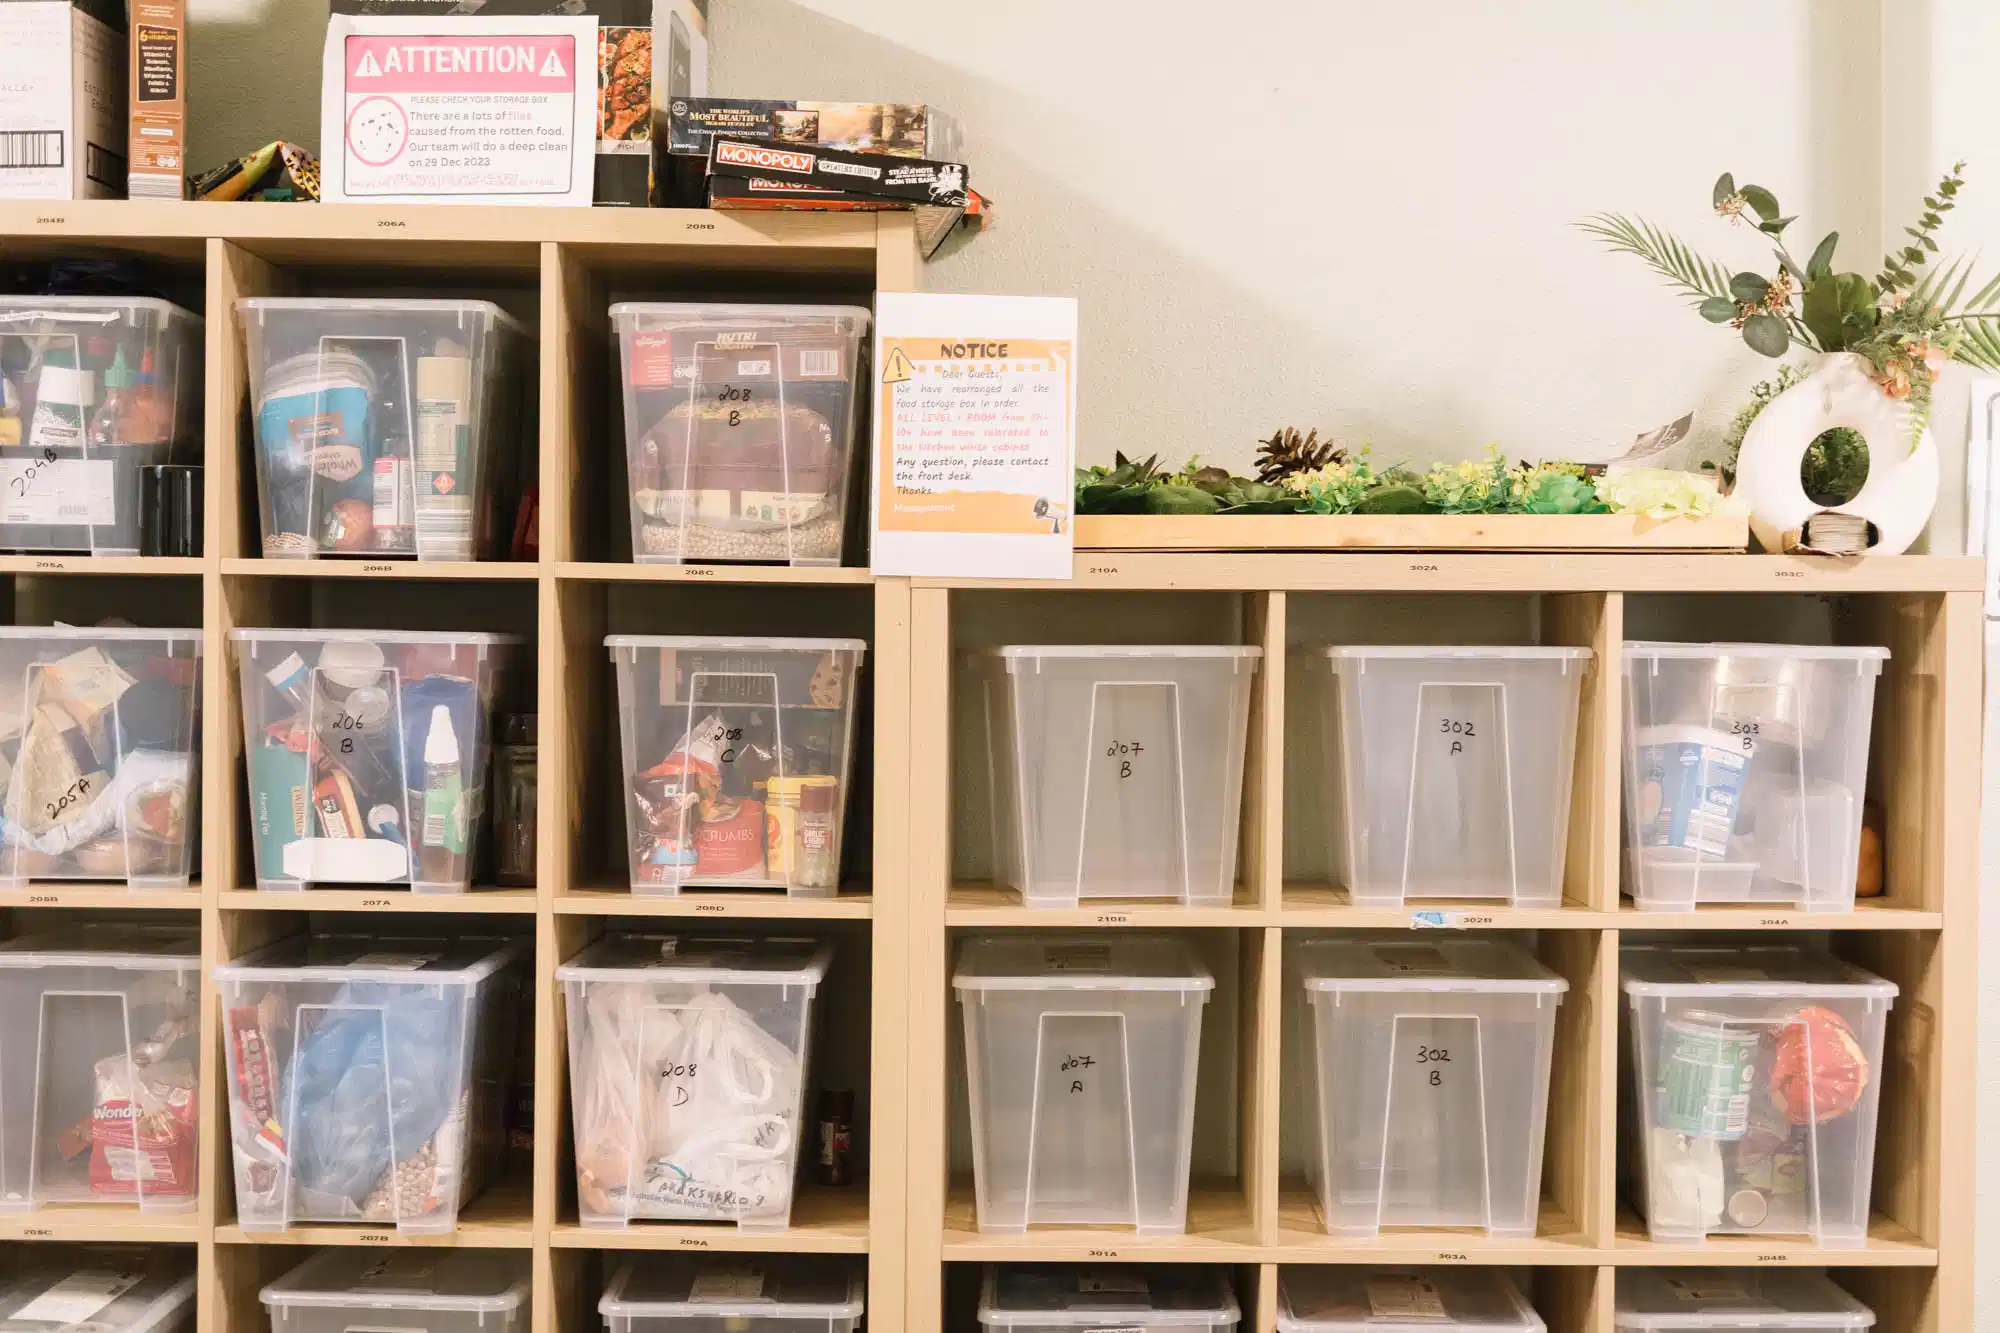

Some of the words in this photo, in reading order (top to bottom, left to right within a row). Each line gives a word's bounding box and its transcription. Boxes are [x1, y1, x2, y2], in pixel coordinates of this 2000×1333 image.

[383, 45, 535, 73] ATTENTION
[410, 96, 440, 104] PLEASE
[470, 96, 492, 104] YOUR
[493, 96, 530, 104] STORAGE
[409, 111, 440, 121] There
[442, 113, 463, 121] are
[472, 111, 492, 121] lots
[494, 111, 507, 121] of
[689, 111, 716, 121] MOST
[717, 113, 769, 123] BEAUTIFUL
[408, 126, 447, 136] caused
[449, 126, 476, 136] from
[478, 126, 497, 136] the
[499, 126, 534, 136] rotten
[536, 126, 565, 136] food.
[408, 142, 428, 152] Our
[431, 143, 459, 152] team
[461, 142, 480, 152] will
[483, 142, 497, 152] do
[507, 142, 536, 153] deep
[538, 142, 568, 152] clean
[408, 159, 422, 168] on
[424, 158, 438, 168] 29
[441, 157, 461, 168] Dec
[463, 157, 491, 167] 2023
[720, 147, 810, 171] MONOPOLY
[940, 343, 1009, 358] NOTICE
[942, 370, 963, 379] Dear
[719, 384, 752, 402] 208
[896, 384, 911, 394] We
[920, 384, 942, 394] have
[951, 384, 1002, 396] rearranged
[1012, 384, 1023, 393] all
[1033, 384, 1049, 393] the
[896, 399, 917, 409] food
[920, 400, 955, 411] storage
[959, 399, 977, 409] box
[981, 400, 990, 408] in
[729, 410, 741, 427] B
[896, 457, 916, 468] Any
[921, 457, 968, 469] question,
[972, 457, 1005, 468] please
[1010, 457, 1049, 466] contact
[896, 471, 914, 481] the
[918, 471, 943, 481] front
[1090, 566, 1118, 574] 210A
[332, 713, 364, 731] 206
[1439, 718, 1476, 737] 302
[713, 726, 744, 741] 208
[340, 737, 354, 754] B
[1106, 739, 1145, 757] 207
[1449, 741, 1463, 756] A
[1742, 736, 1753, 750] B
[720, 748, 735, 763] C
[1119, 760, 1133, 779] B
[46, 778, 91, 821] 205A
[1415, 1045, 1452, 1063] 302
[661, 1062, 699, 1078] 208
[1060, 1054, 1097, 1071] 207
[1429, 1070, 1442, 1086] B
[672, 1086, 689, 1107] D
[679, 1238, 709, 1246] 209A
